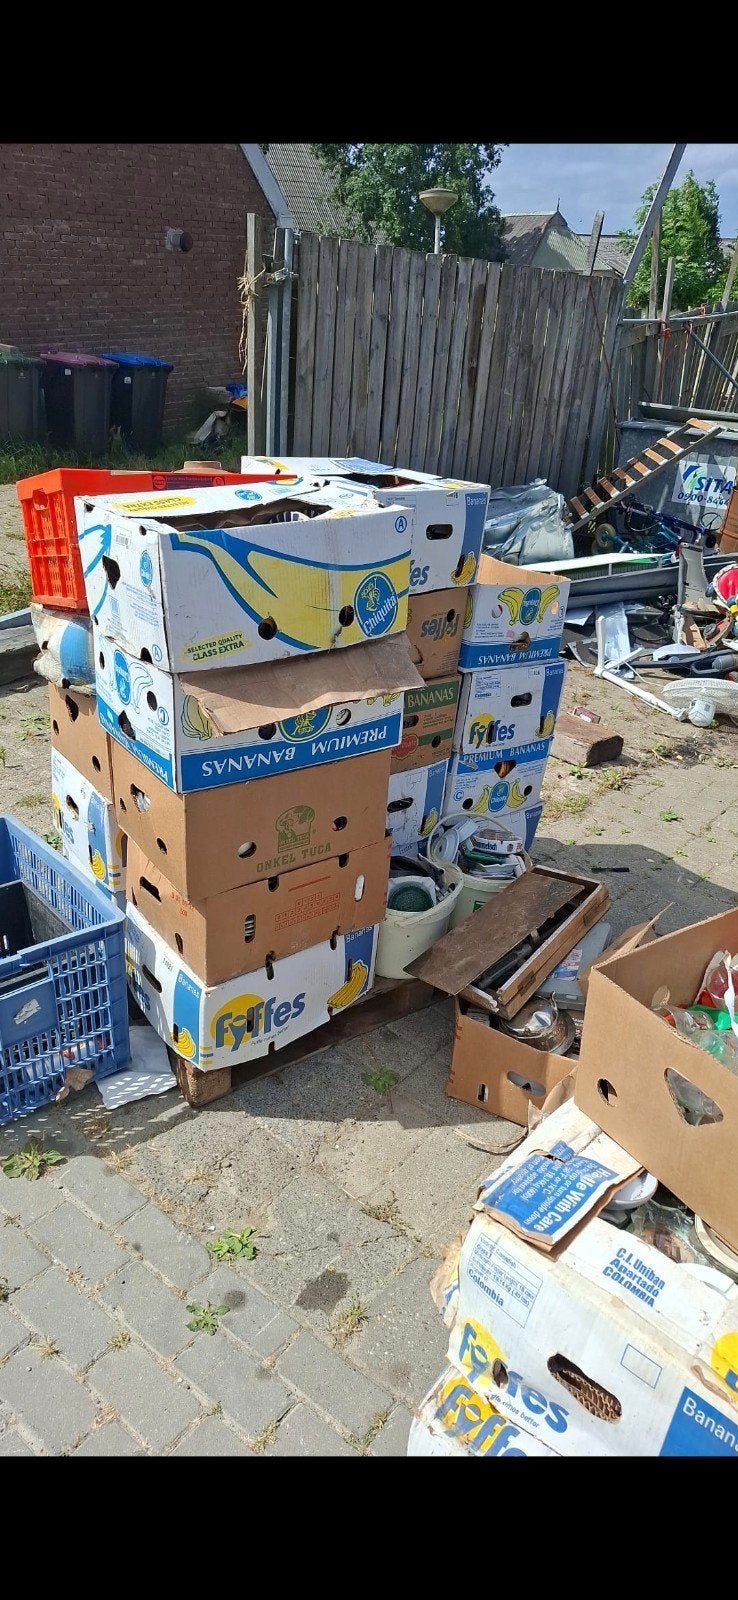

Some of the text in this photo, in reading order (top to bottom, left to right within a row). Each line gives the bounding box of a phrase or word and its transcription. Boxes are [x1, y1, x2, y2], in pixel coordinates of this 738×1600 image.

[694, 477, 733, 495] SITA
[363, 595, 399, 634] Chiquita
[187, 634, 243, 654] SELECTED QUALITY
[192, 641, 245, 661] CLASS EXTRA
[478, 652, 517, 665] BANANAS
[407, 688, 454, 708] BANANAS
[311, 725, 388, 756] PREMIUM
[463, 750, 504, 764] PREMIUM
[510, 742, 546, 757] BANANAS
[202, 747, 296, 777] BANANAS
[256, 853, 296, 873] ONKEL
[301, 842, 332, 859] TUCA
[178, 973, 200, 999] Bananas
[554, 1189, 585, 1214] With
[534, 1210, 562, 1231] Care
[609, 1258, 660, 1298] Apartadó
[616, 1247, 666, 1290] C.I. Uniban
[468, 1268, 504, 1307] Colombia
[602, 1266, 655, 1307] COLOMBIA
